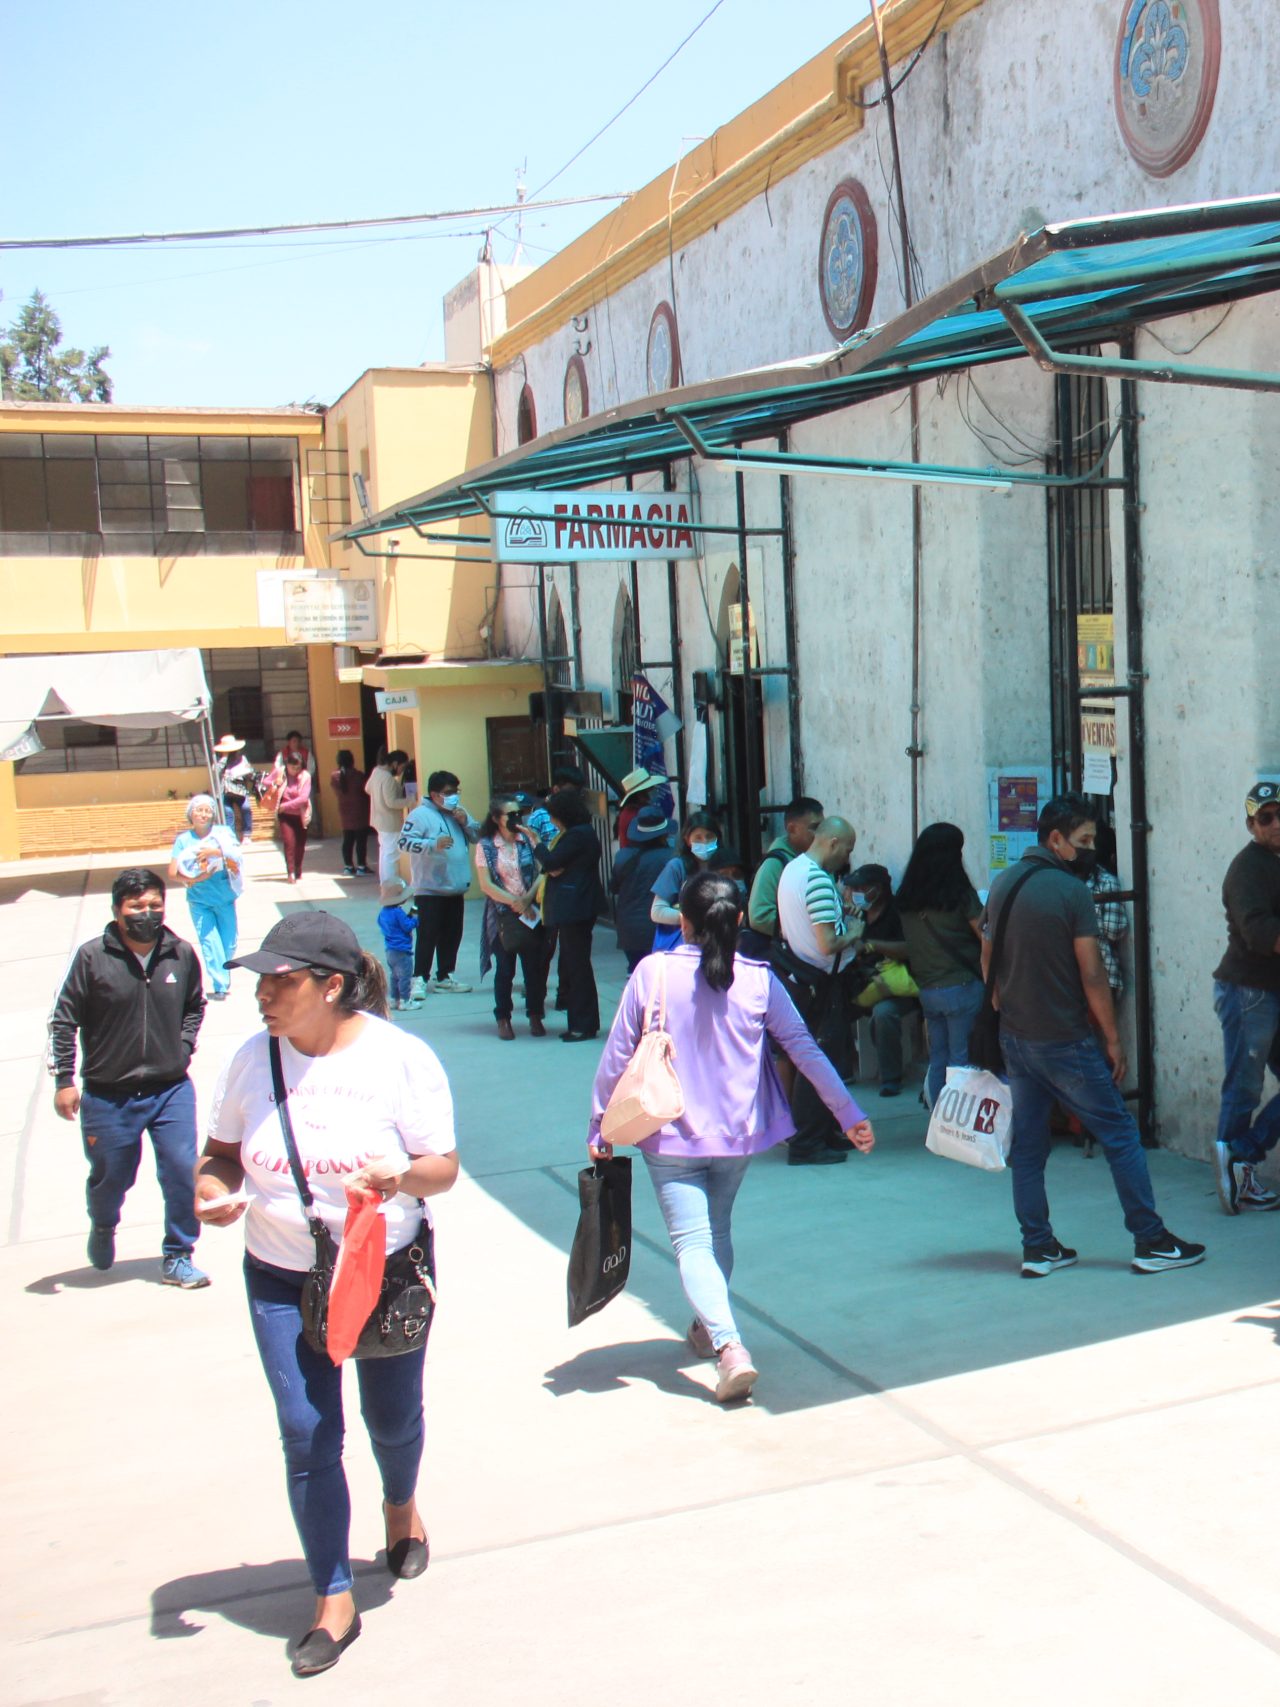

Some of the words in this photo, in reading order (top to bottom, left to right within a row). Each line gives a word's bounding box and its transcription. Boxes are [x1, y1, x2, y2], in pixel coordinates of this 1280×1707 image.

[554, 504, 693, 549] FARMACIA
[385, 696, 408, 705] CAJA
[1086, 722, 1115, 747] VENTAS
